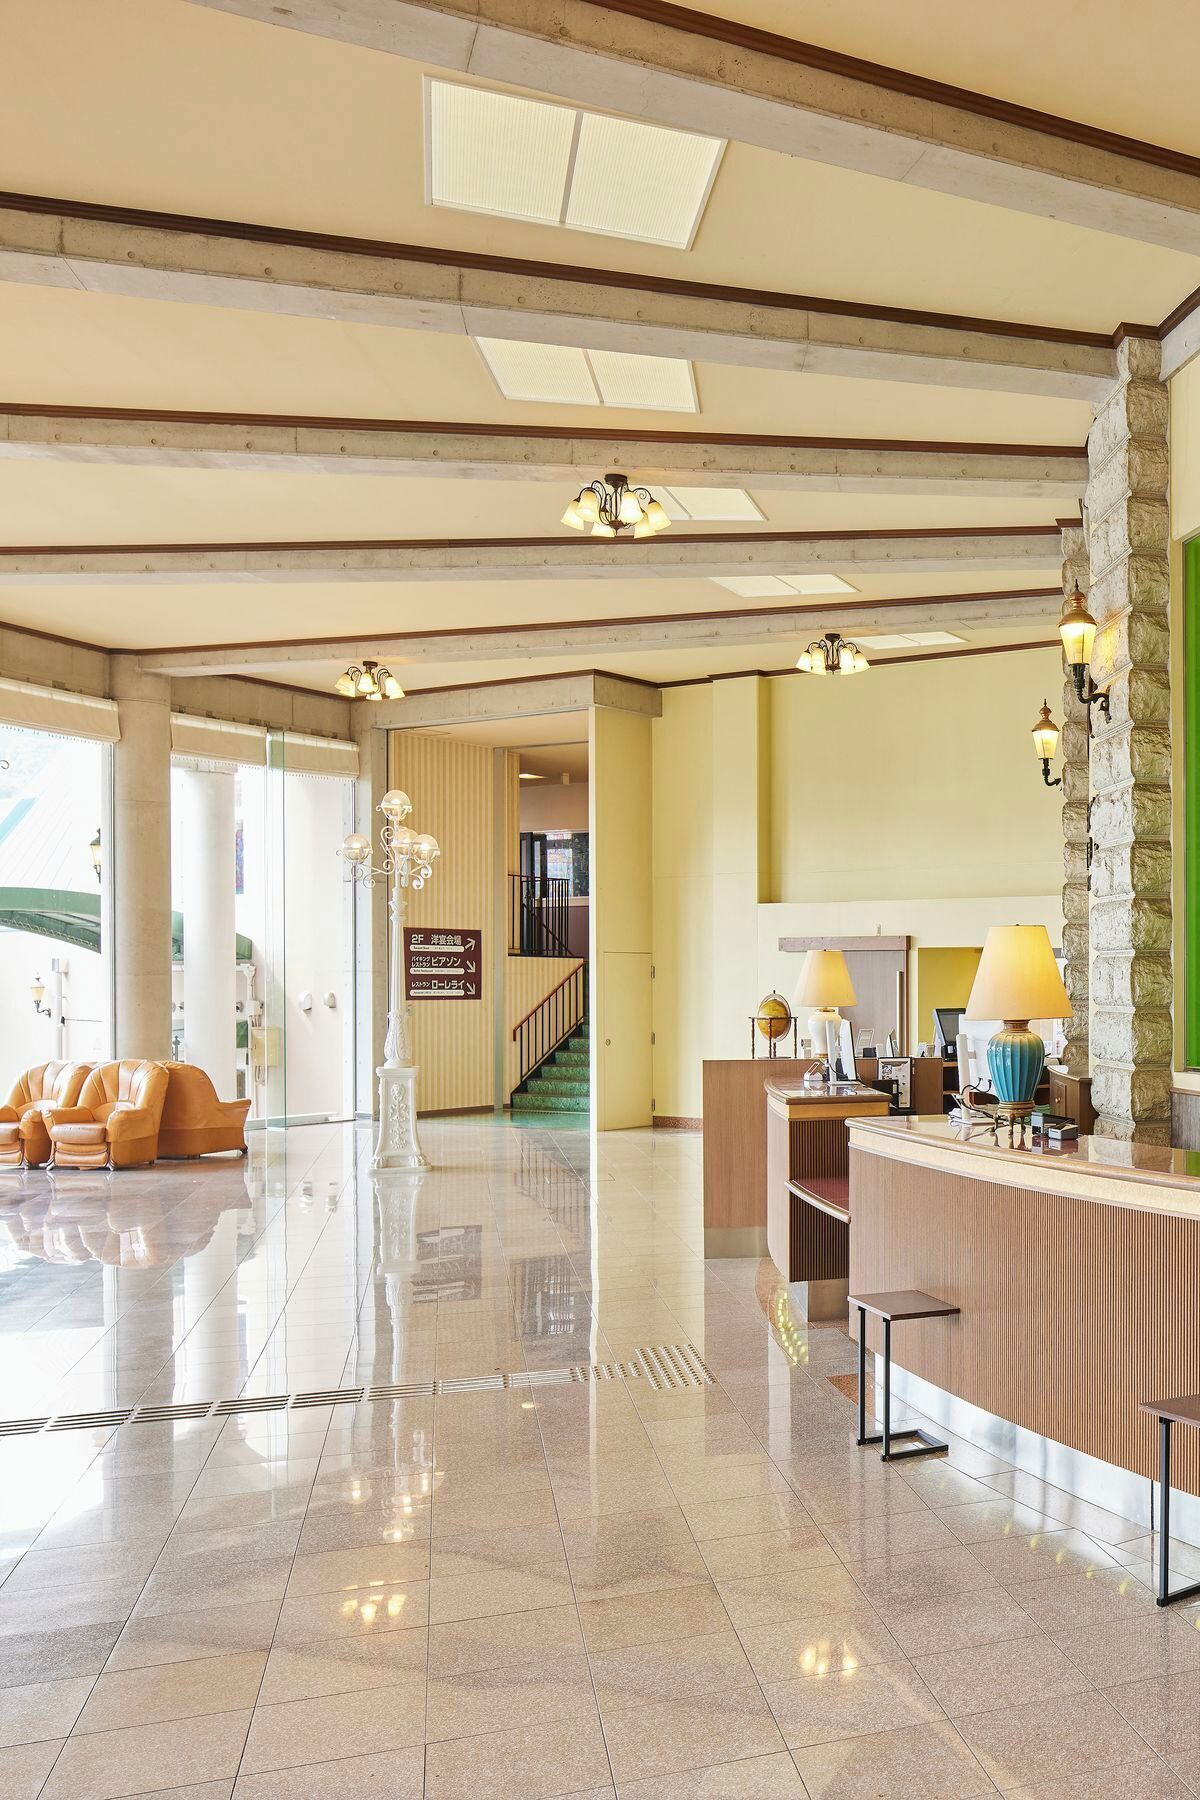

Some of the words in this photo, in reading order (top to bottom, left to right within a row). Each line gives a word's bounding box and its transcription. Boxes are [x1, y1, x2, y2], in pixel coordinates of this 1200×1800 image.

[411, 934, 424, 944] 2F
[431, 934, 462, 945] 洋宴会場
[431, 980, 465, 990] ローレライ
